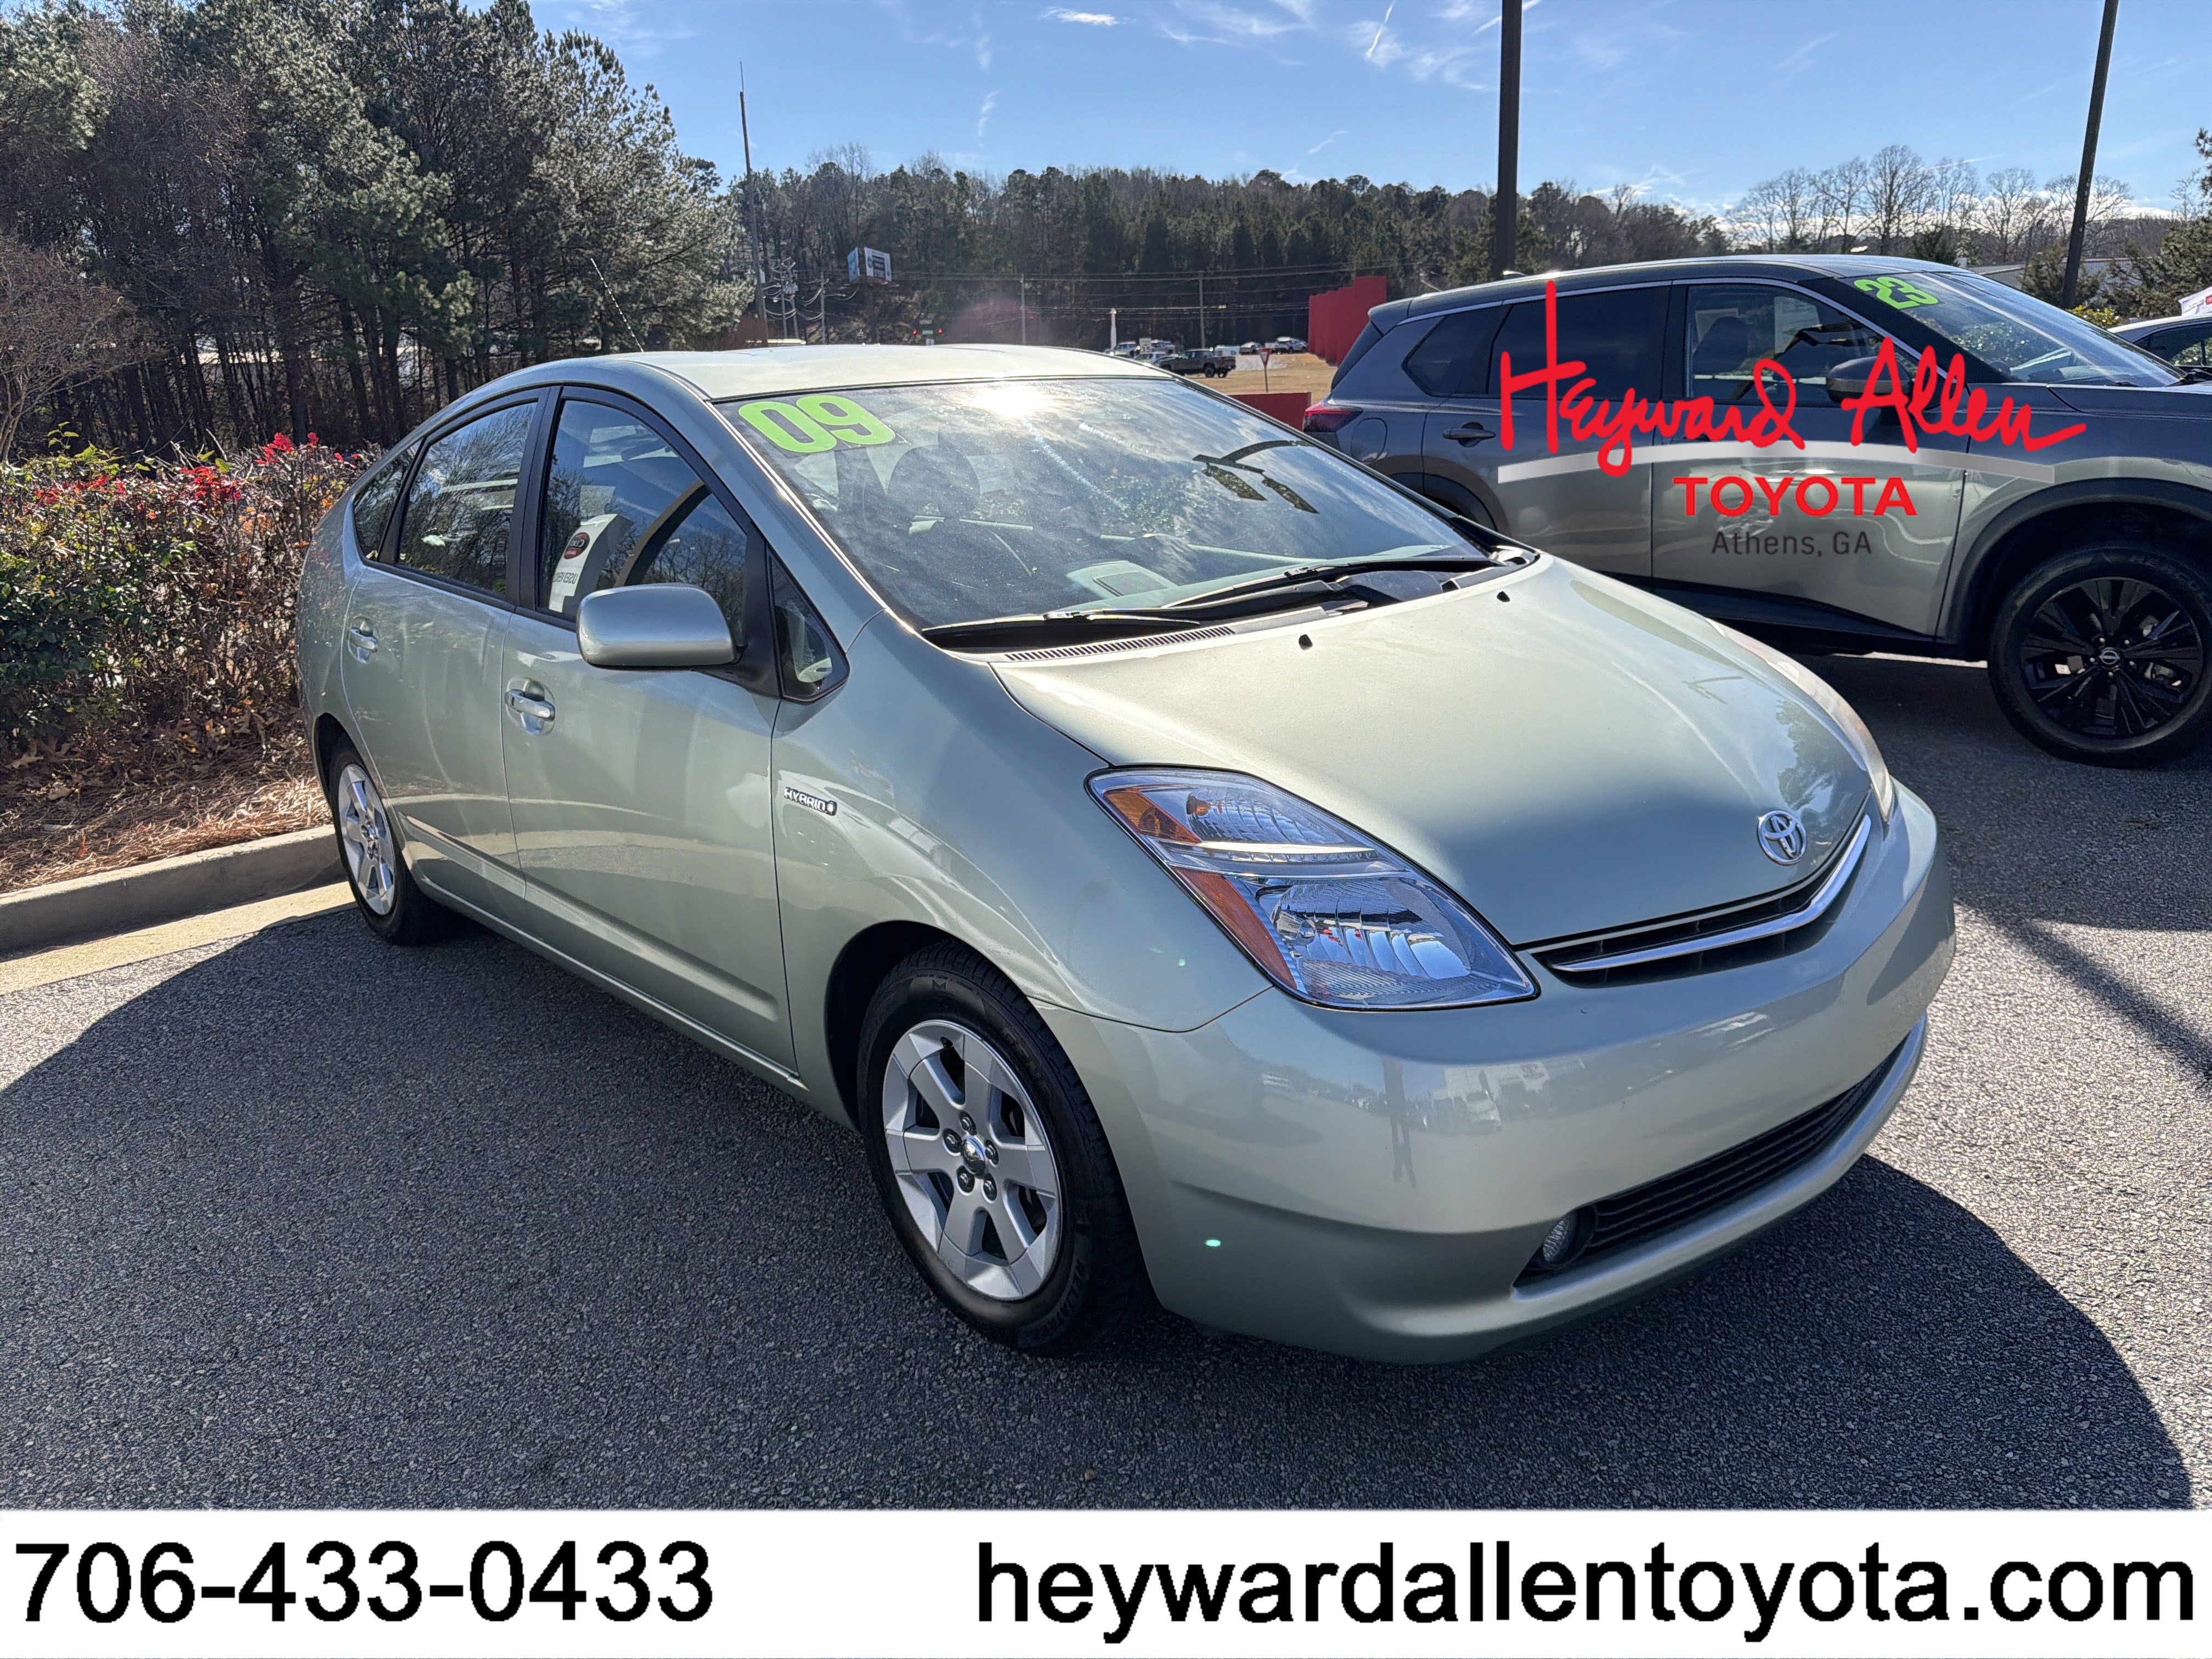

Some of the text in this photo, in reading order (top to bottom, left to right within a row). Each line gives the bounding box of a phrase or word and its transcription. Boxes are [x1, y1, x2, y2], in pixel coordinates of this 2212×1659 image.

[1854, 277, 1938, 309] 23
[739, 395, 895, 453] 09
[783, 787, 827, 814] HYBRID
